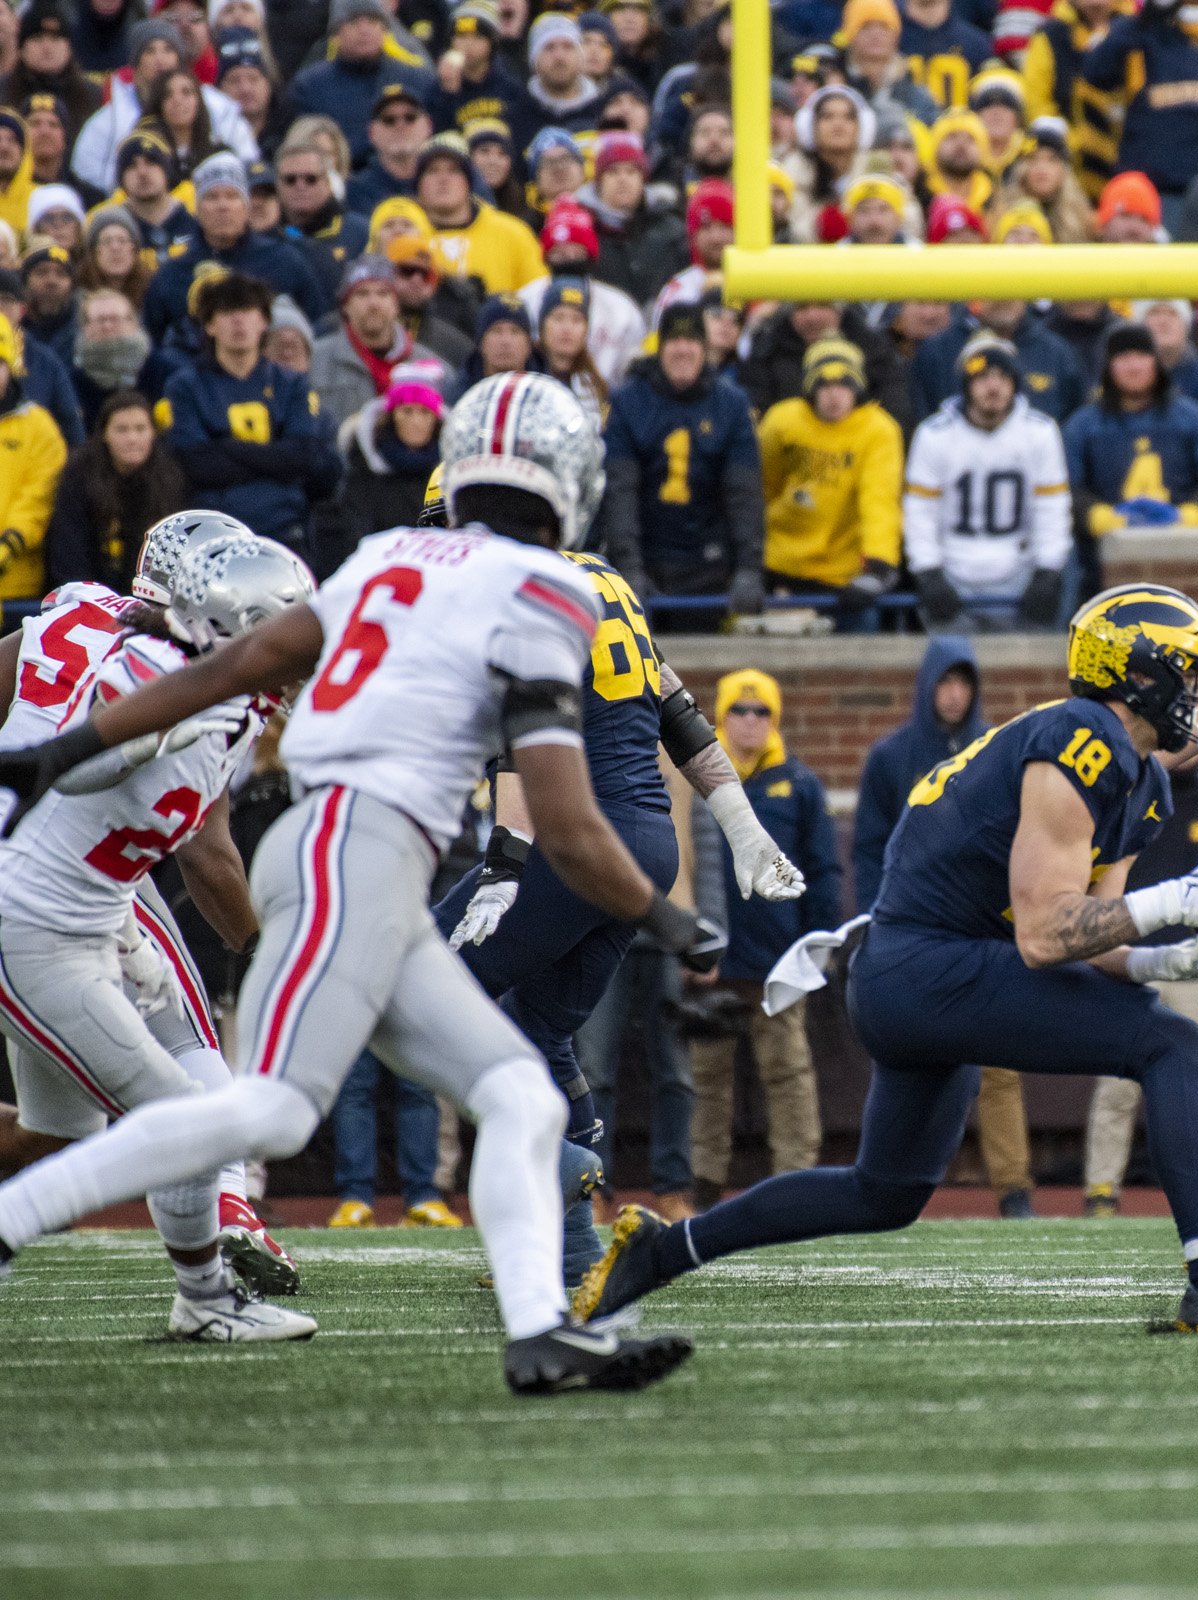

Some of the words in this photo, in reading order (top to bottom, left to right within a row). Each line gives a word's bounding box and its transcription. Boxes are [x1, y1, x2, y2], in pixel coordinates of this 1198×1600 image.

[658, 427, 691, 504] 1
[952, 468, 1026, 537] 10
[19, 600, 126, 708] 5
[312, 566, 423, 711] 6
[1058, 727, 1112, 788] 18
